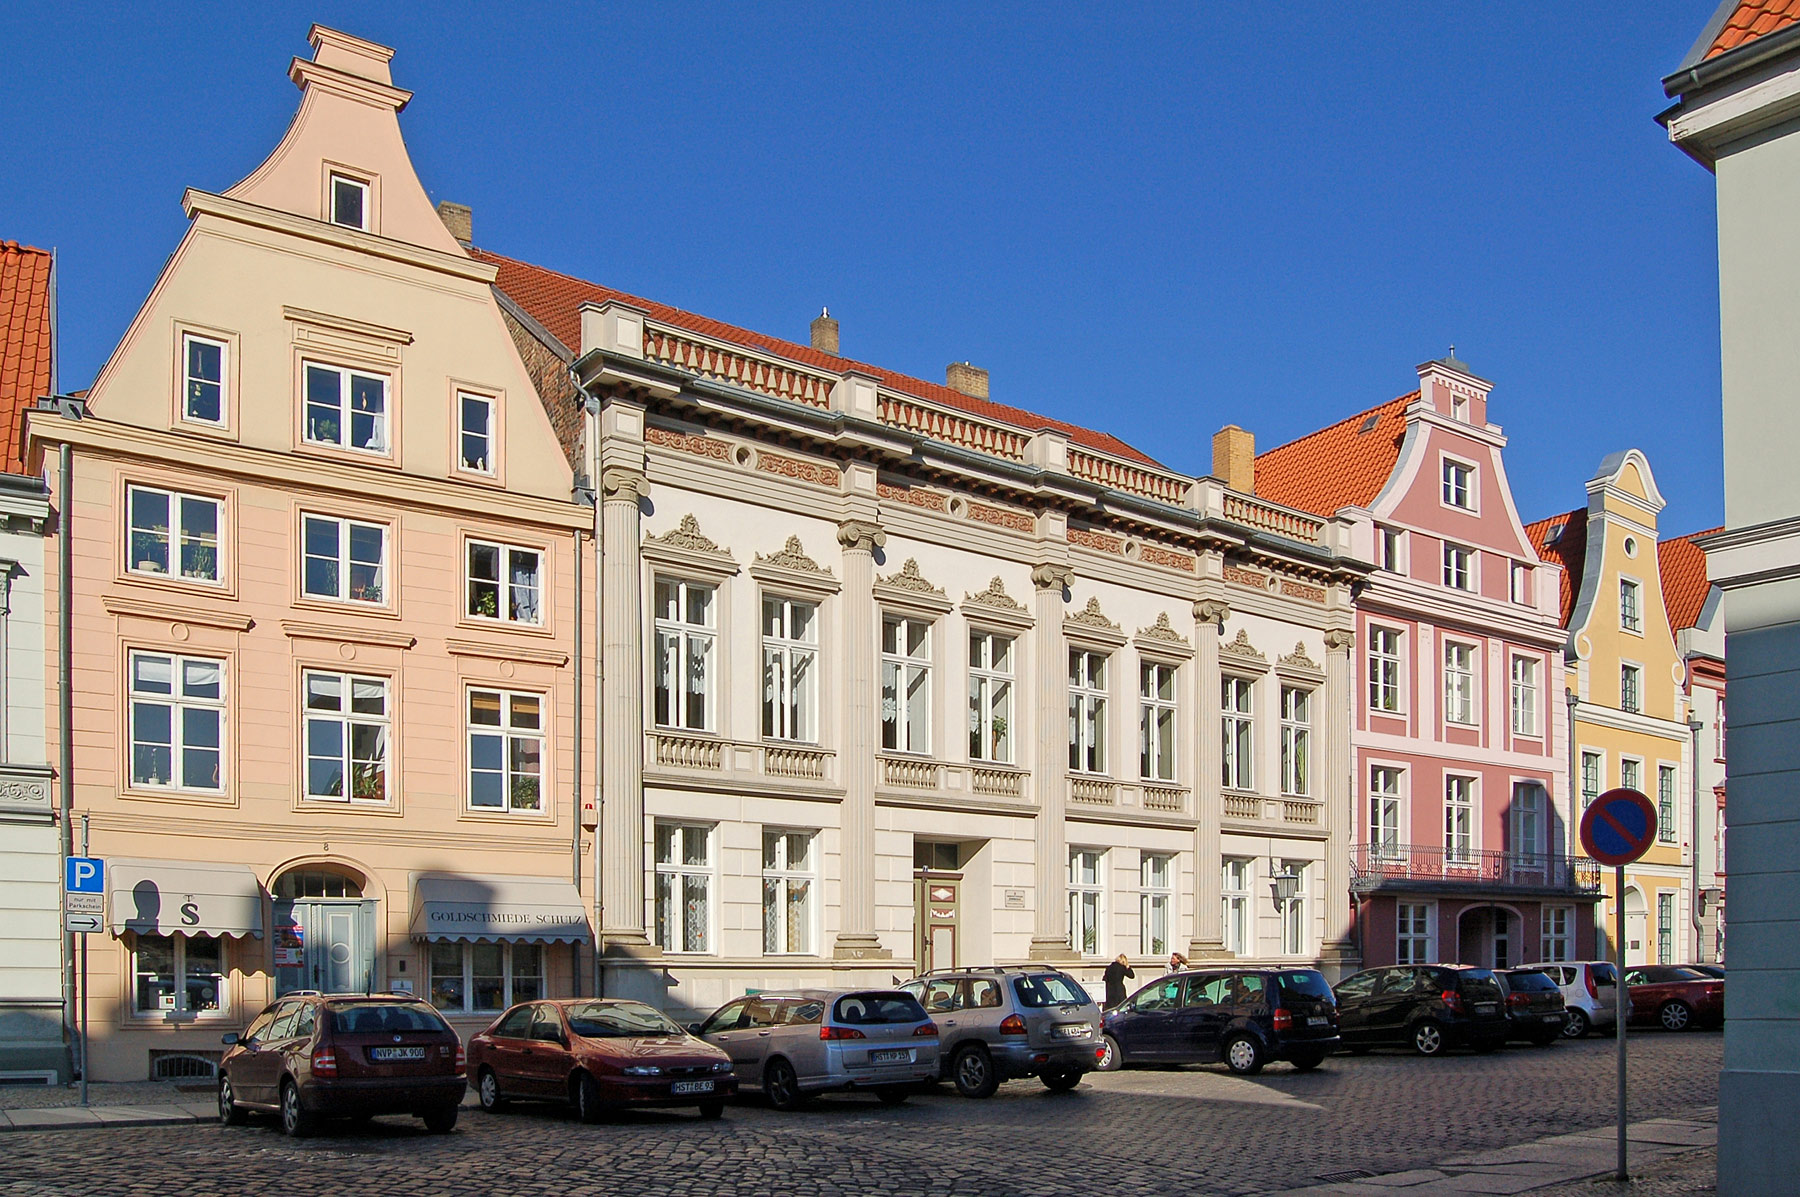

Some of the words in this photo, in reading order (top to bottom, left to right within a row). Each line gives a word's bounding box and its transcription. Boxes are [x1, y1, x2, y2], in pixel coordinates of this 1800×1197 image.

[75, 861, 96, 888] P
[68, 902, 102, 910] Parkschein
[180, 903, 200, 925] S
[431, 911, 531, 924] GOLDSCHMIEDE
[535, 914, 583, 925] SCHULZ
[376, 1047, 393, 1058] NVP
[409, 1047, 424, 1057] 900
[675, 1082, 690, 1092] HST
